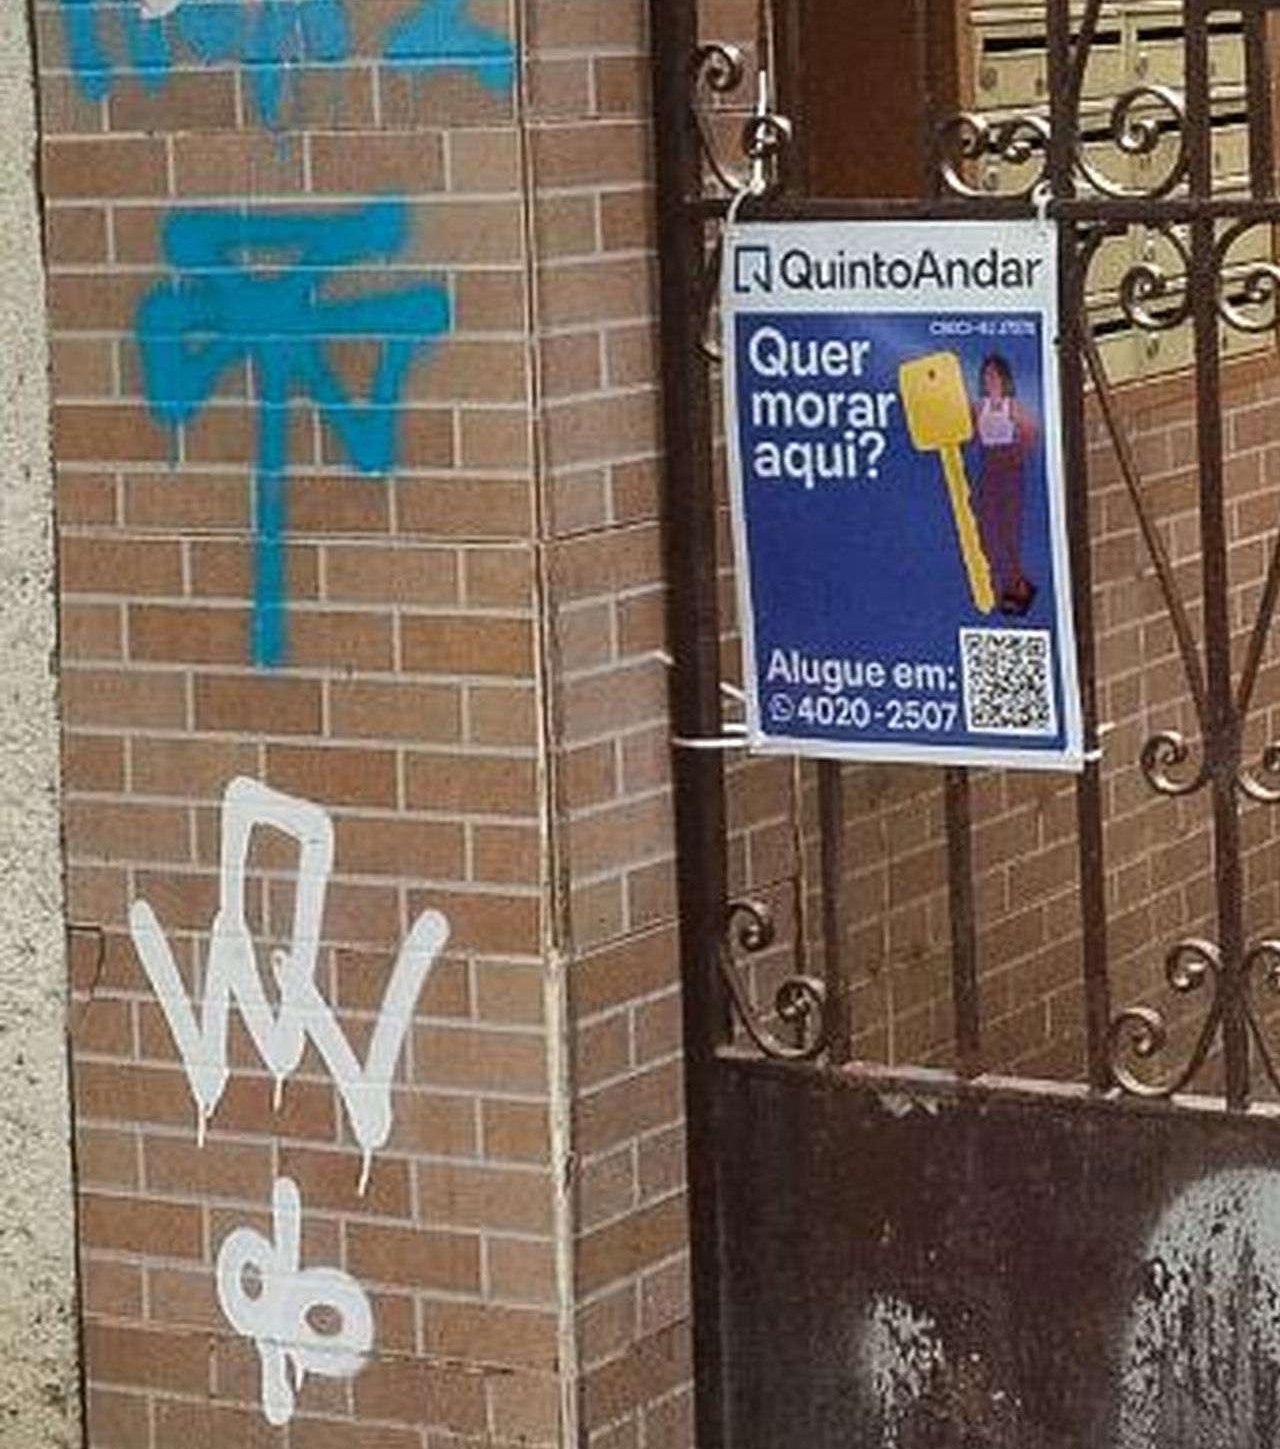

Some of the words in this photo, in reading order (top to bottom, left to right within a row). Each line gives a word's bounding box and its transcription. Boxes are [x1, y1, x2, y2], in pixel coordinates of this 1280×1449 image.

[780, 248, 1042, 290] QuintoAndar
[750, 325, 871, 377] Quer
[752, 390, 897, 428] morar
[753, 430, 886, 489] aqui?
[767, 649, 886, 694] Alugue
[893, 662, 958, 691] em:
[797, 696, 958, 732] 4020-2507
